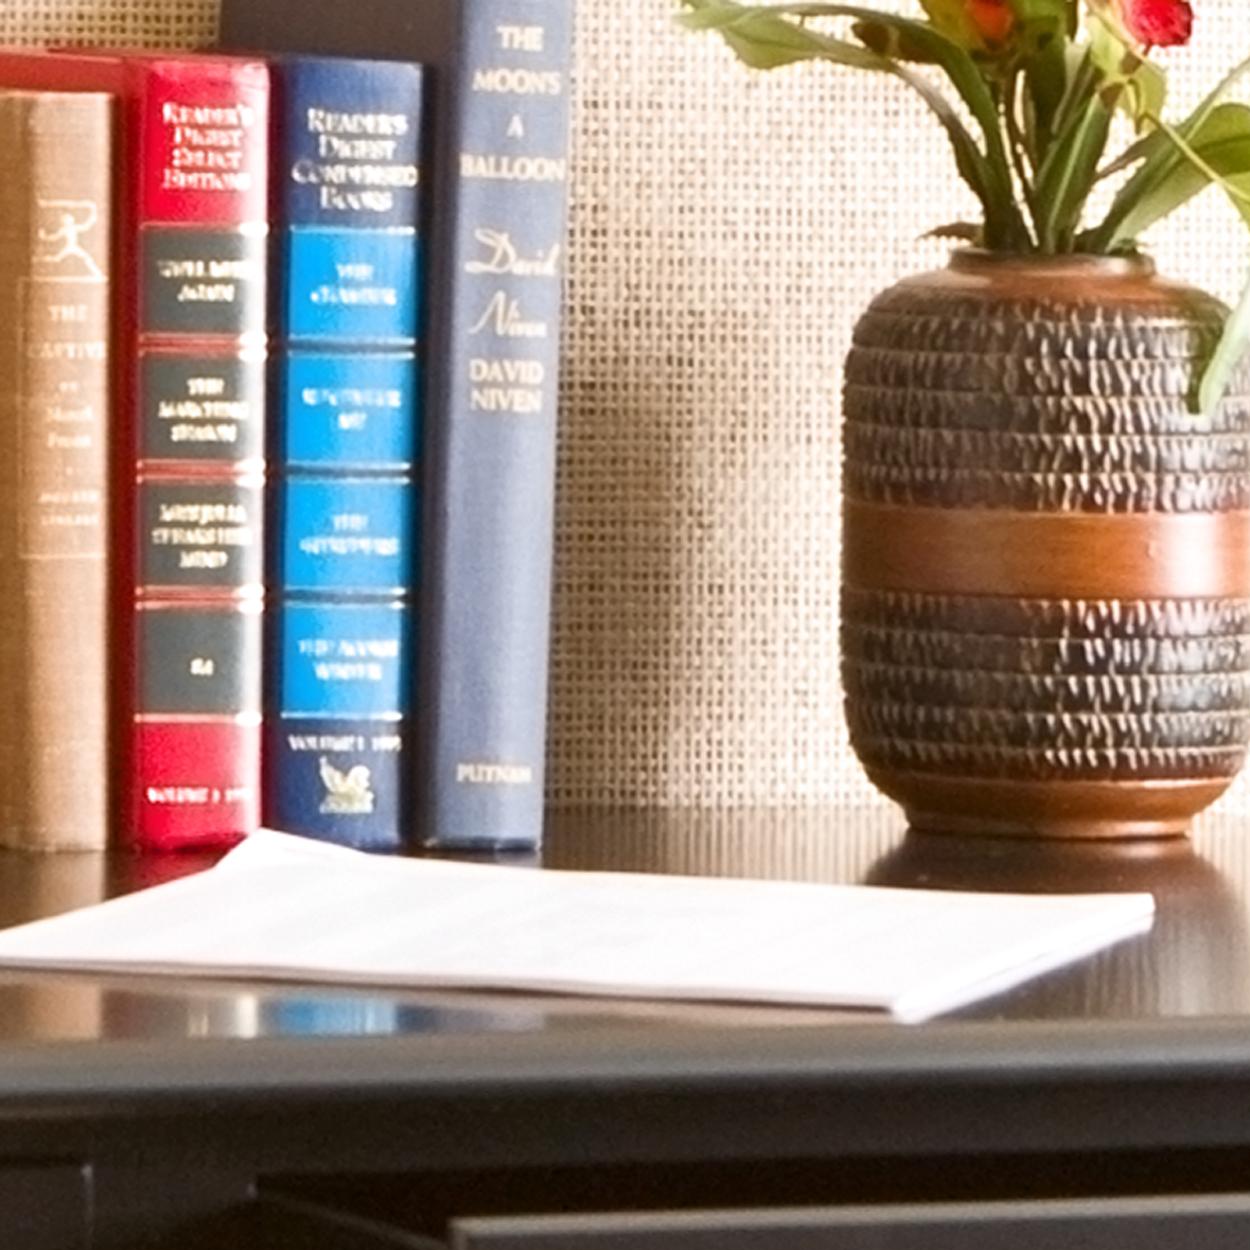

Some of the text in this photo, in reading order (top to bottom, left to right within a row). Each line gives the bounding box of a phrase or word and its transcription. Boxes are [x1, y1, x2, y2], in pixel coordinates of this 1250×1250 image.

[497, 25, 545, 52] THE
[506, 113, 525, 139] A
[459, 153, 566, 181] BALLOON
[469, 358, 545, 384] DAVID
[470, 388, 543, 413] NIVEN
